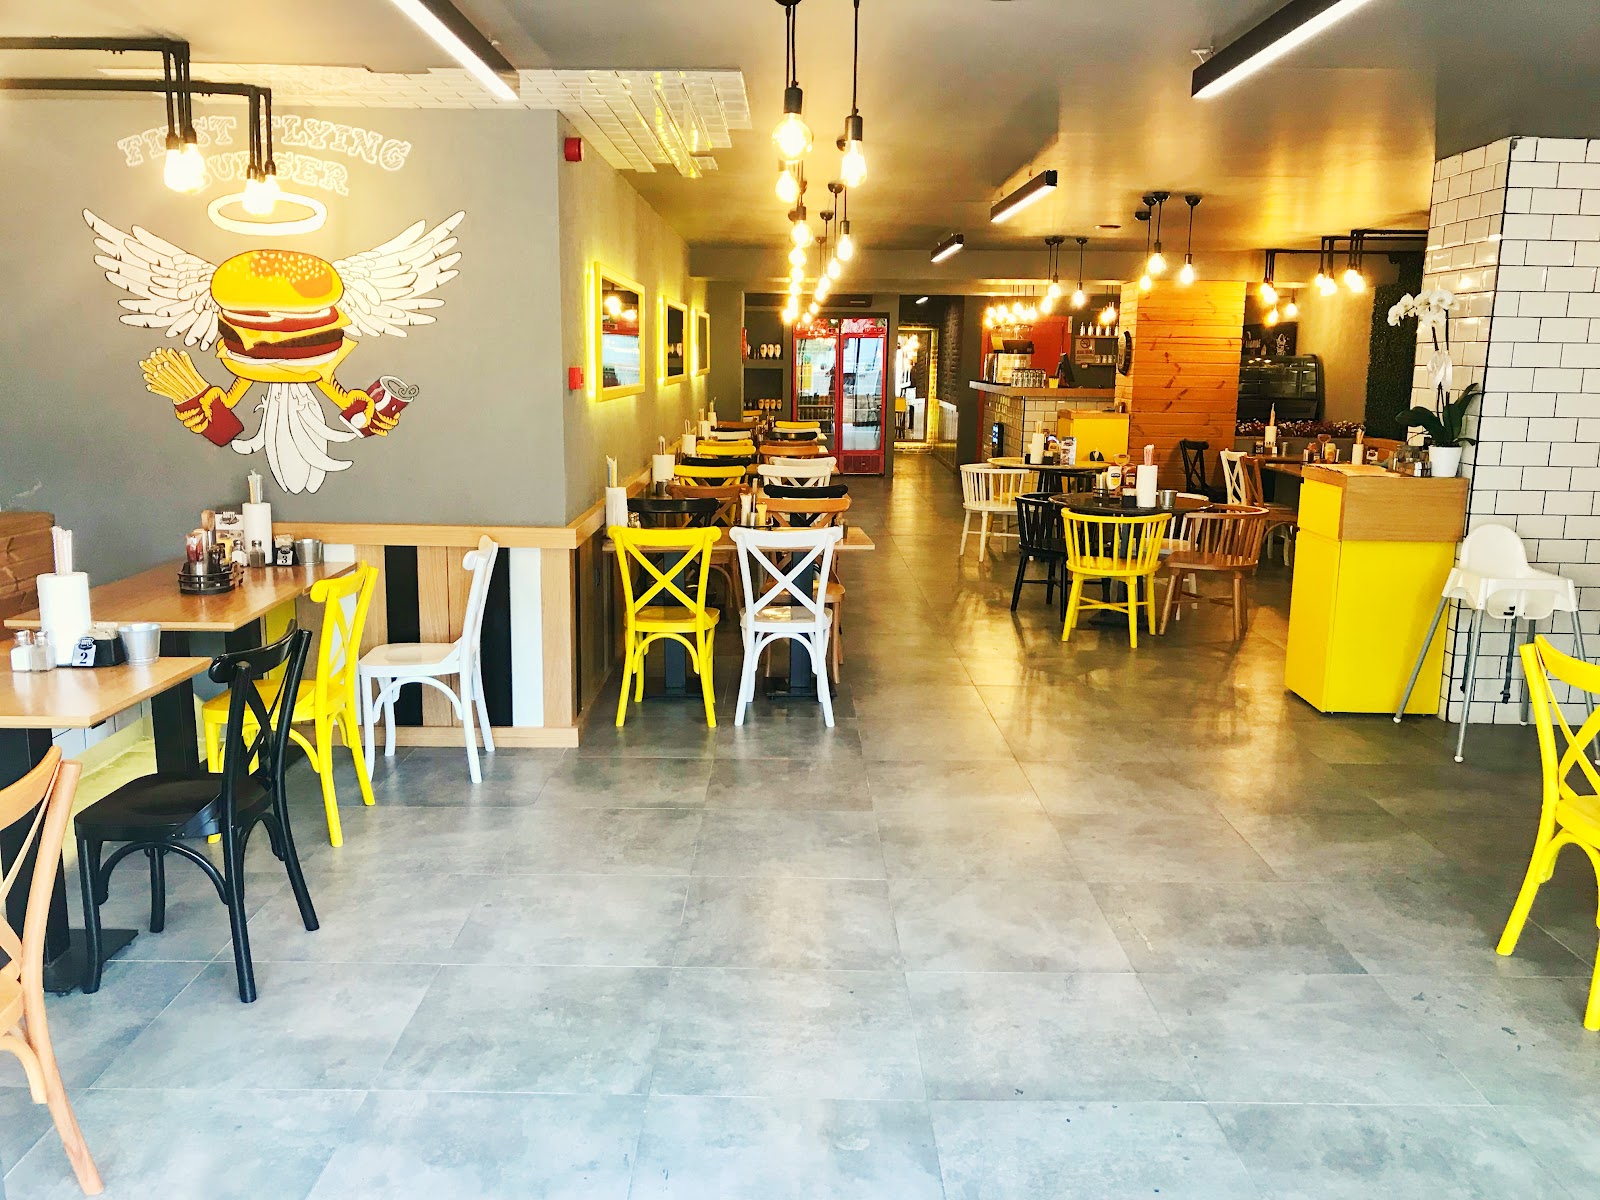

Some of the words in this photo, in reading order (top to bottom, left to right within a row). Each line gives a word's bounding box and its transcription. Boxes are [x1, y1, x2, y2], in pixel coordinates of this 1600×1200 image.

[116, 115, 236, 167] FIST
[259, 114, 412, 172] FLYING
[281, 555, 288, 564] 3
[79, 651, 88, 664] 2
